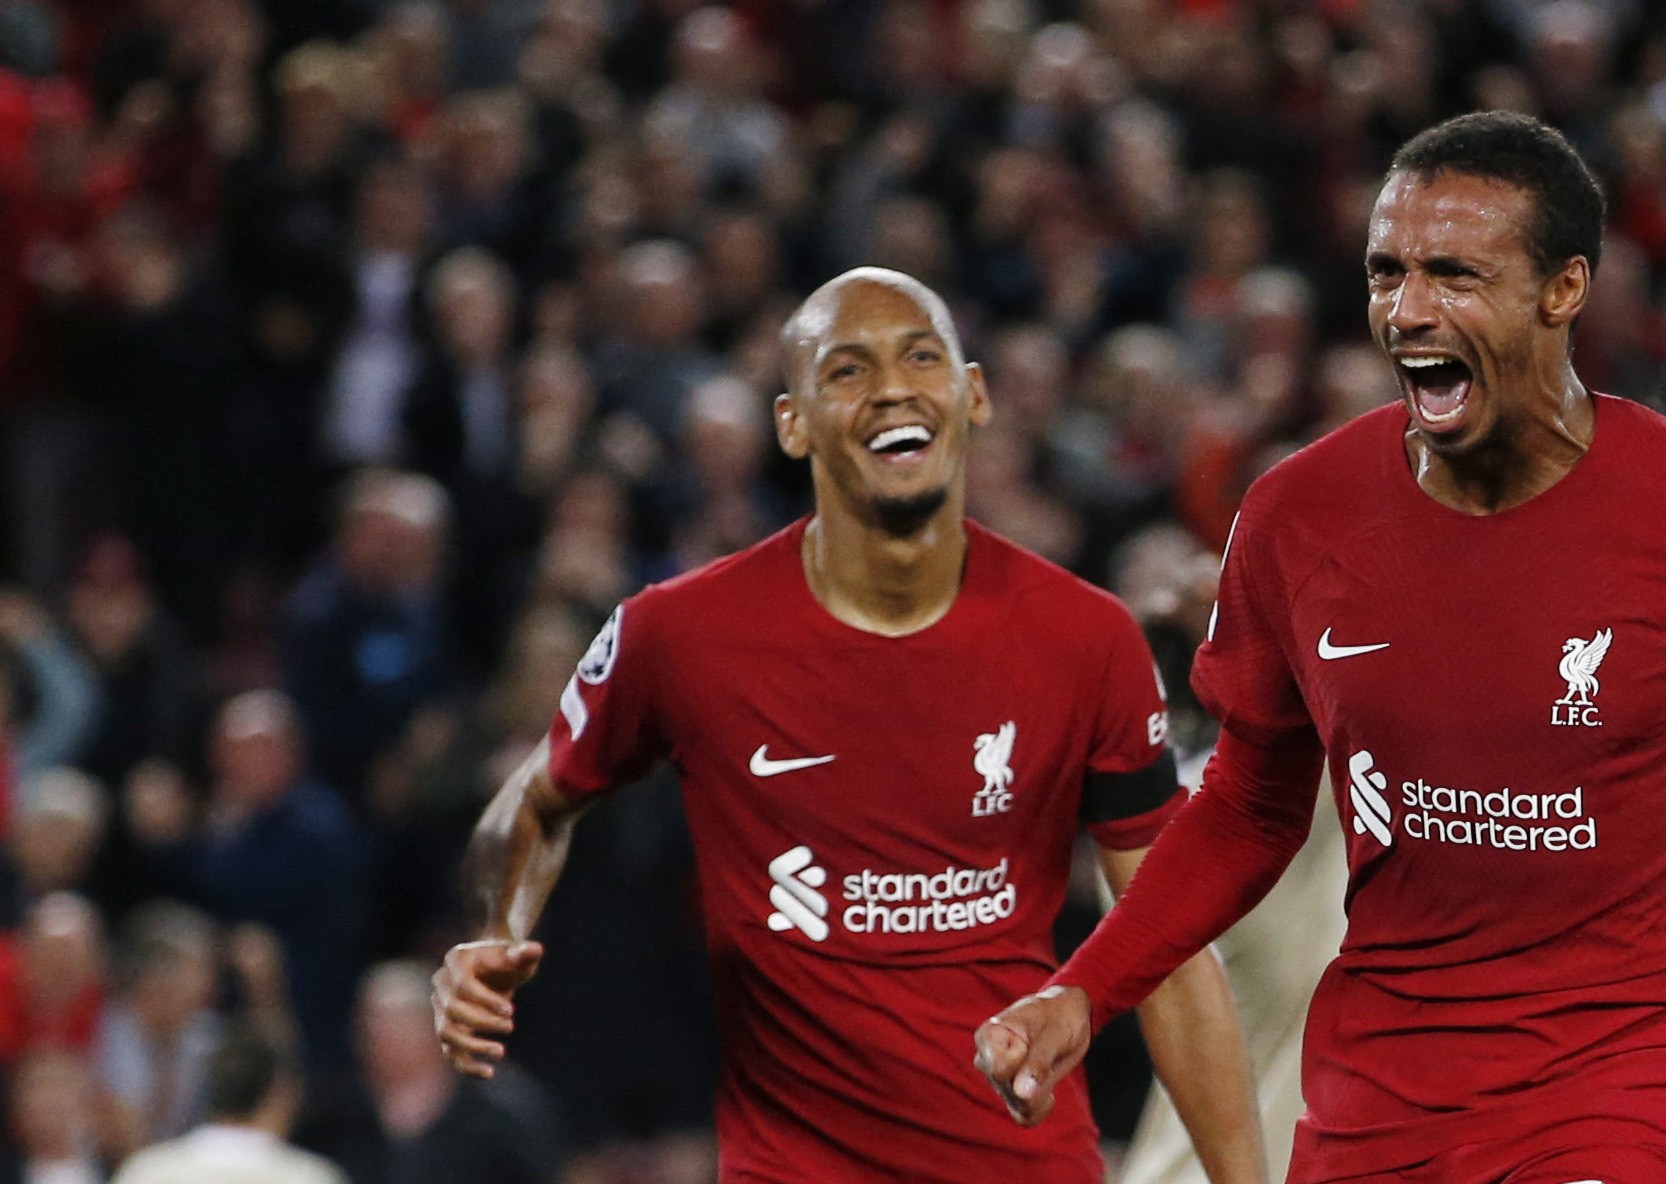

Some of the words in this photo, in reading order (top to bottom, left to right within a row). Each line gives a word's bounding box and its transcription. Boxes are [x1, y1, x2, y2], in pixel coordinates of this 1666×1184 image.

[1402, 778, 1583, 820] standard
[1404, 809, 1598, 852] chartered
[842, 857, 1008, 903] standard
[842, 885, 1017, 935] chartered
